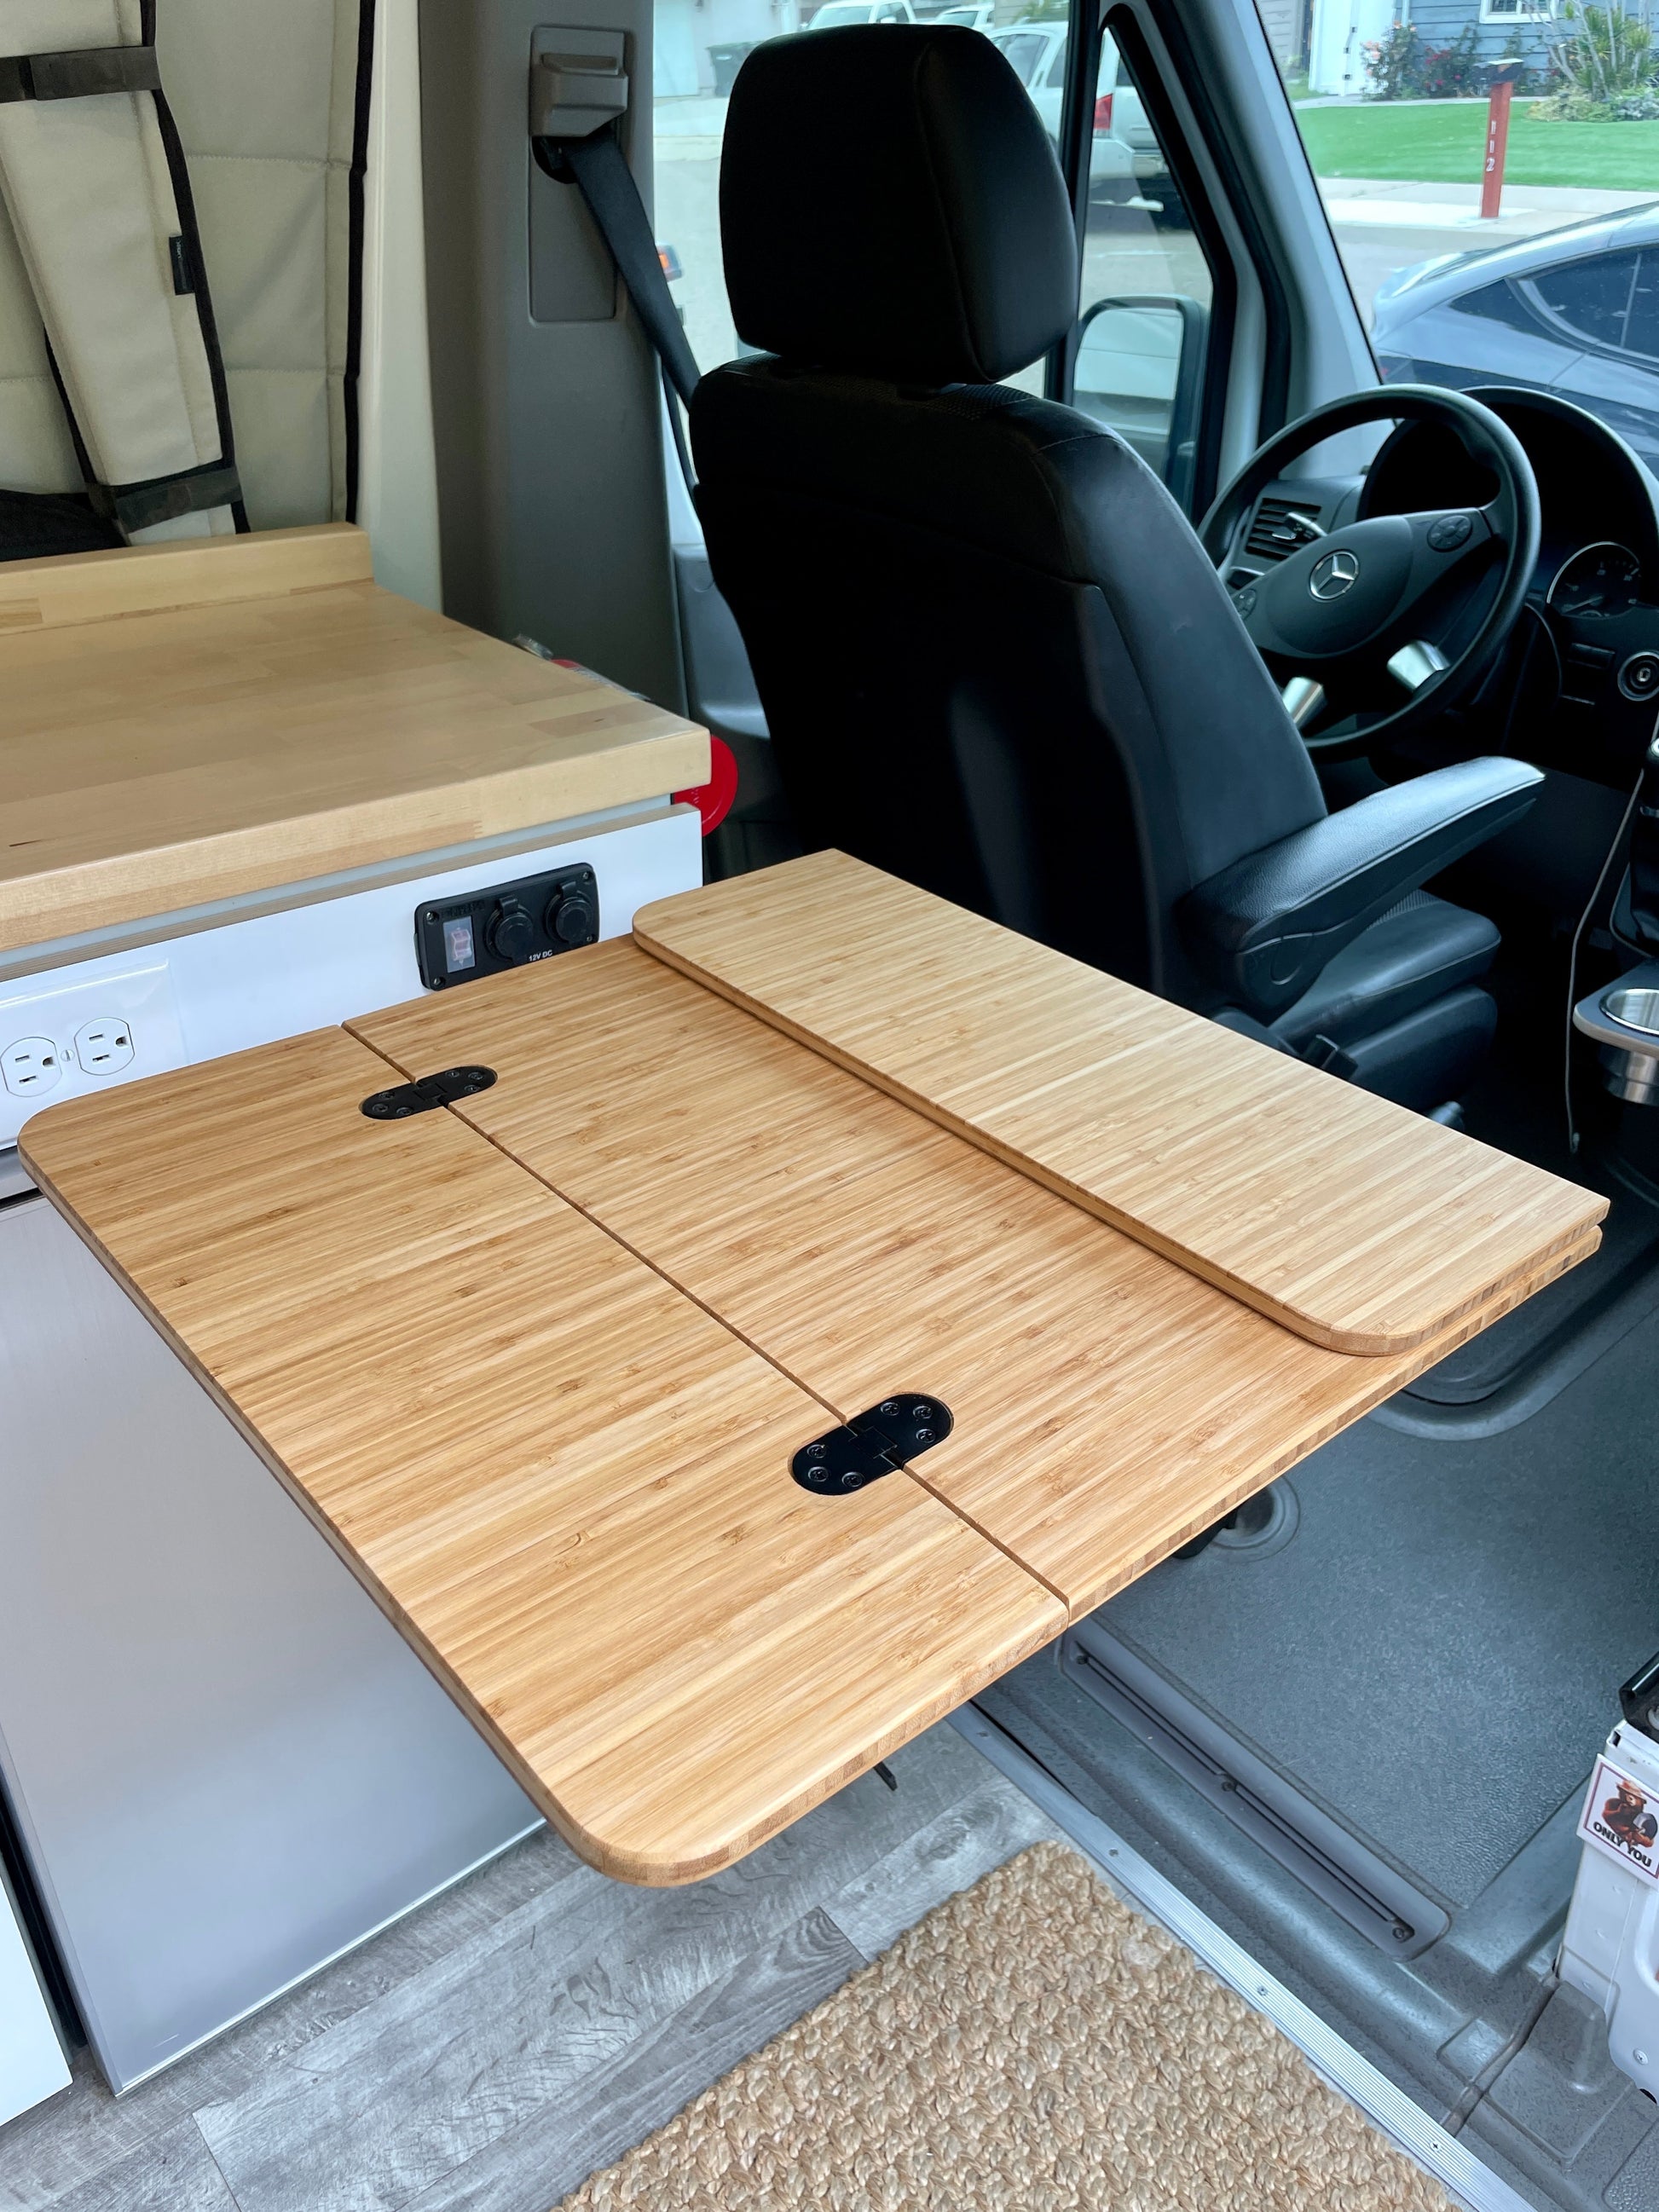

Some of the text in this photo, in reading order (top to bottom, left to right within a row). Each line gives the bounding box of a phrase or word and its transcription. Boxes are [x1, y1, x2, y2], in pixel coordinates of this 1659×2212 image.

[529, 950, 553, 962] 12V DC
[1593, 1822, 1652, 1868] ONLY YOU
